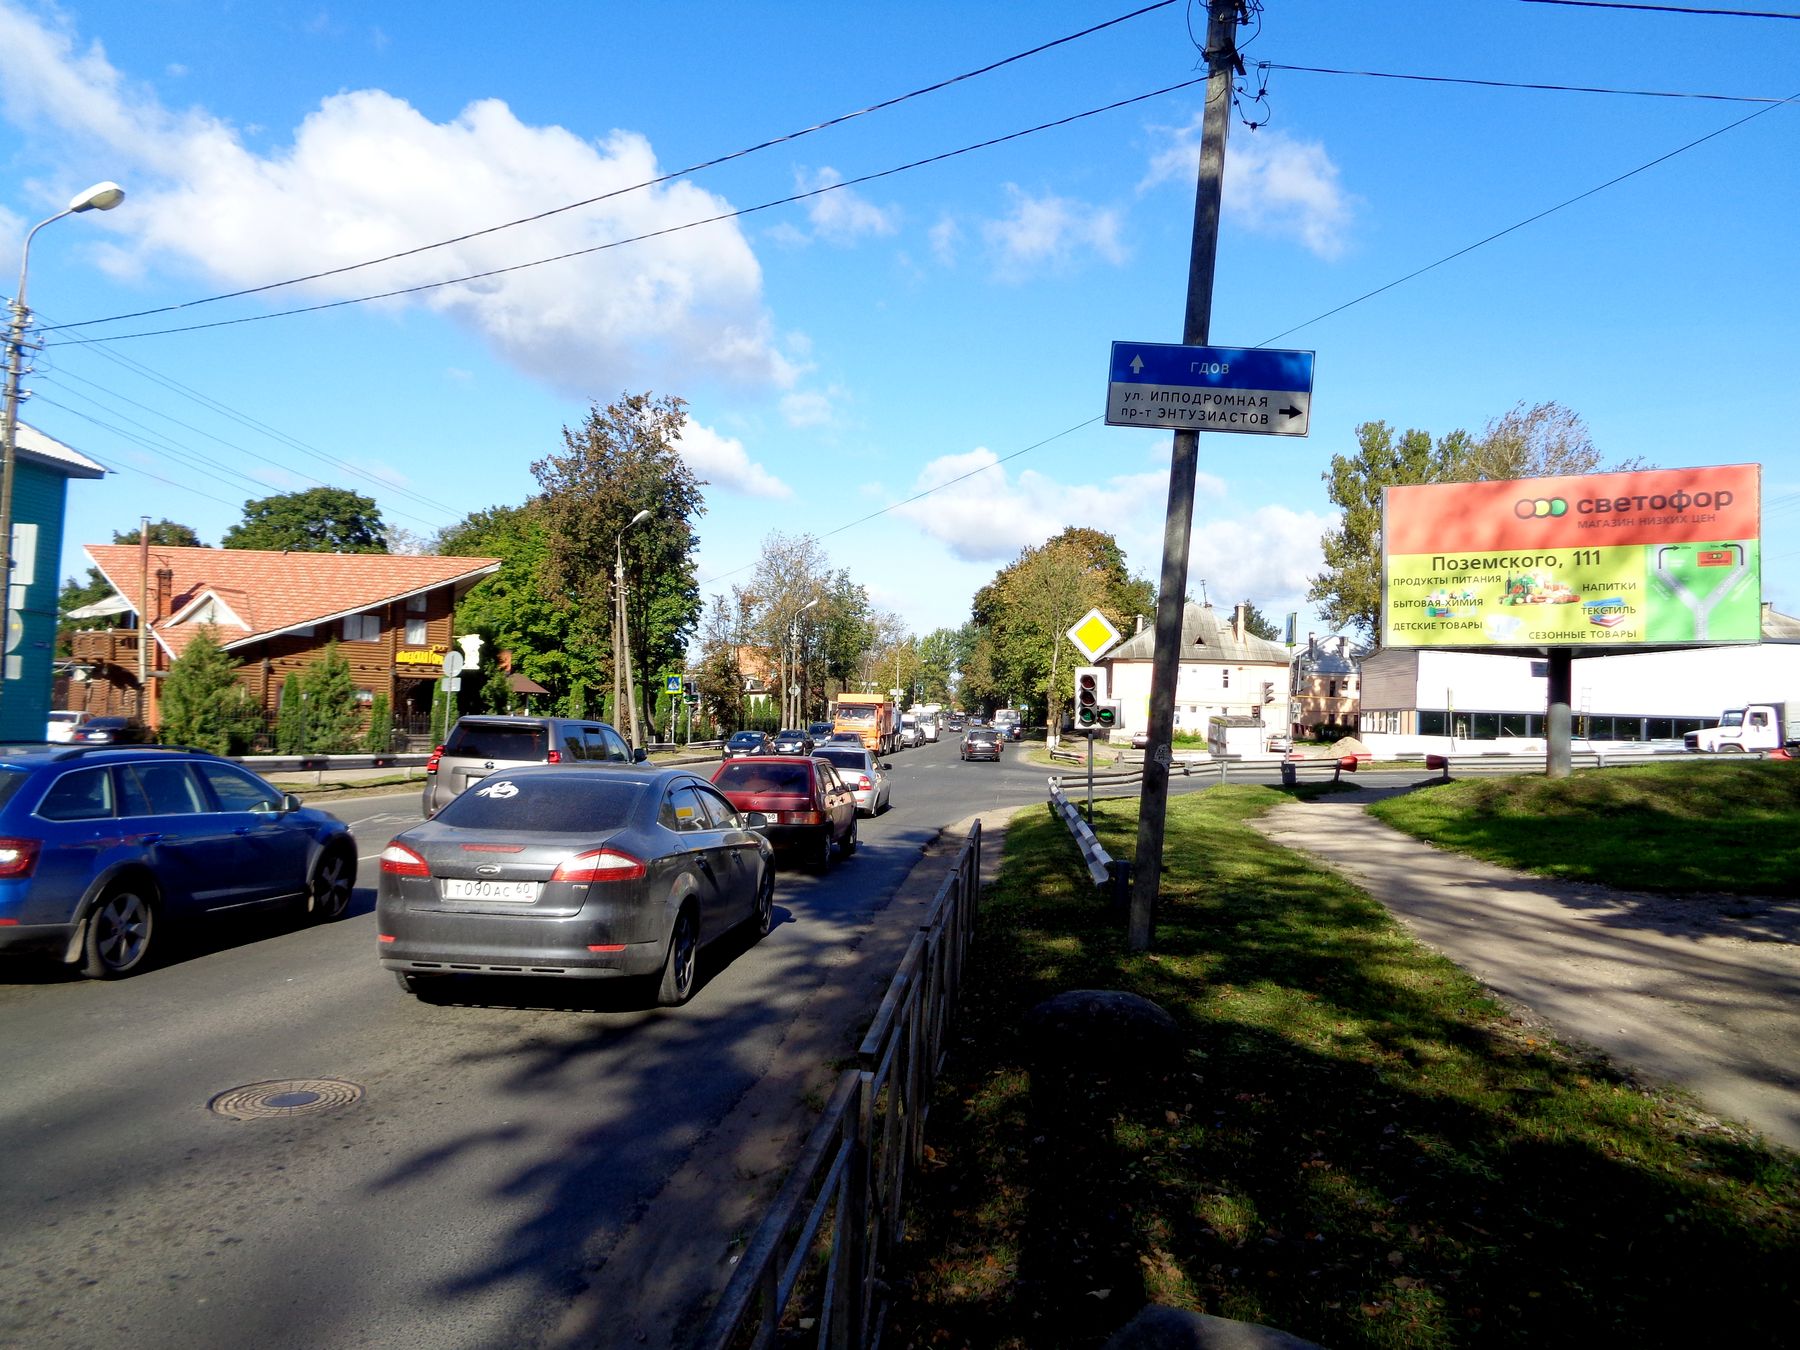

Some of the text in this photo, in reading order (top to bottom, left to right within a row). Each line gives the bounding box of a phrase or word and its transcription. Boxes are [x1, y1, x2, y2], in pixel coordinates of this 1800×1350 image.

[1191, 362, 1229, 375] ГДОВ
[1125, 391, 1268, 408] ул. ИППОДРОМНАЯ
[1121, 408, 1269, 425] пр-т ЭНТУЗИАСТОВ
[1576, 489, 1734, 515] светофор
[1577, 513, 1716, 529] МАГАЗИН НИЗКИХ ЦЕН
[1432, 550, 1601, 571] Поземского, 111
[1393, 575, 1502, 586] ПРОДУКТЫ ПИТАНИЯ
[1582, 582, 1637, 592] НАПИТКИ
[1581, 606, 1637, 615] ТЕКСТИЛЬ
[1393, 621, 1483, 631] ДЕТСКИЕ ТОВАРЫ
[1528, 630, 1637, 640] СЕЗОННЫЕ ТОВАРЫ
